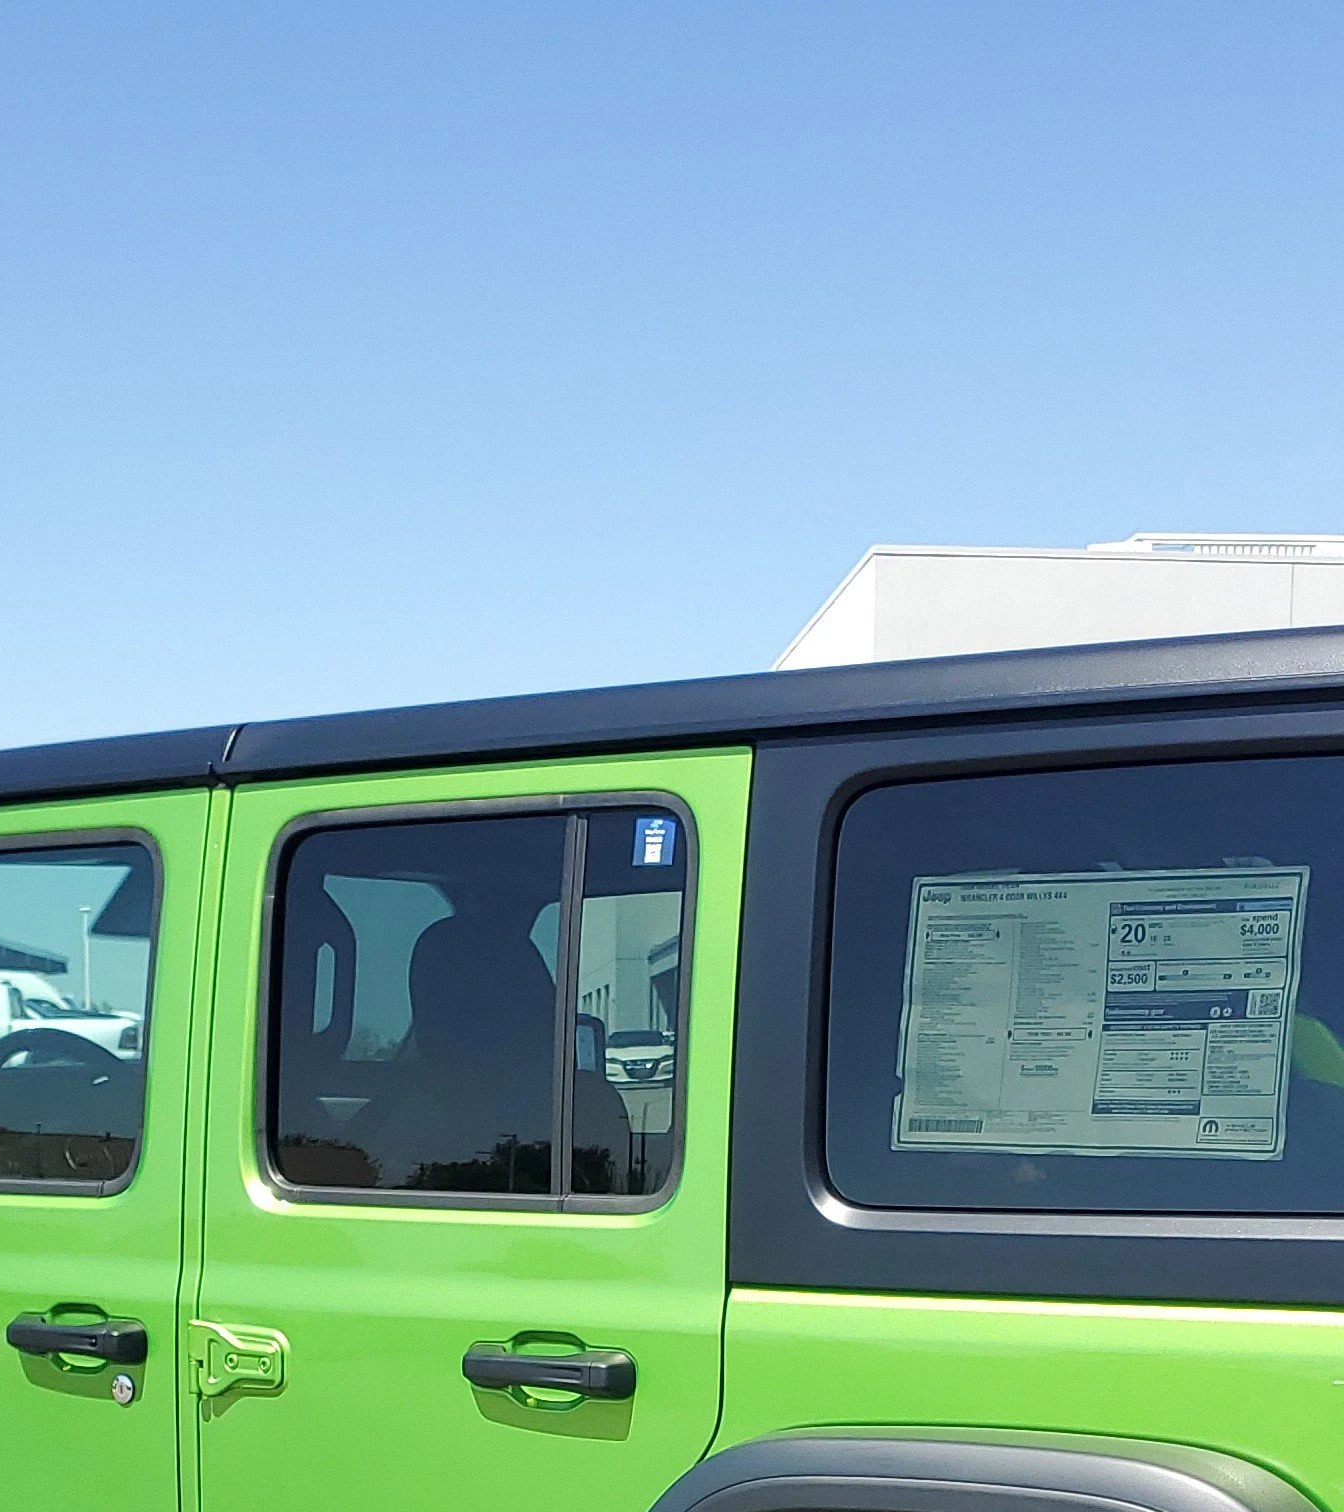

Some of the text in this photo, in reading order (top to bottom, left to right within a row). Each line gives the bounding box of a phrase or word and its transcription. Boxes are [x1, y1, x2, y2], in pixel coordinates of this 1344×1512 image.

[1251, 913, 1279, 923] spend
[1120, 923, 1147, 944] 20
[1239, 923, 1280, 937] $4,000
[1110, 973, 1149, 986] $2,500
